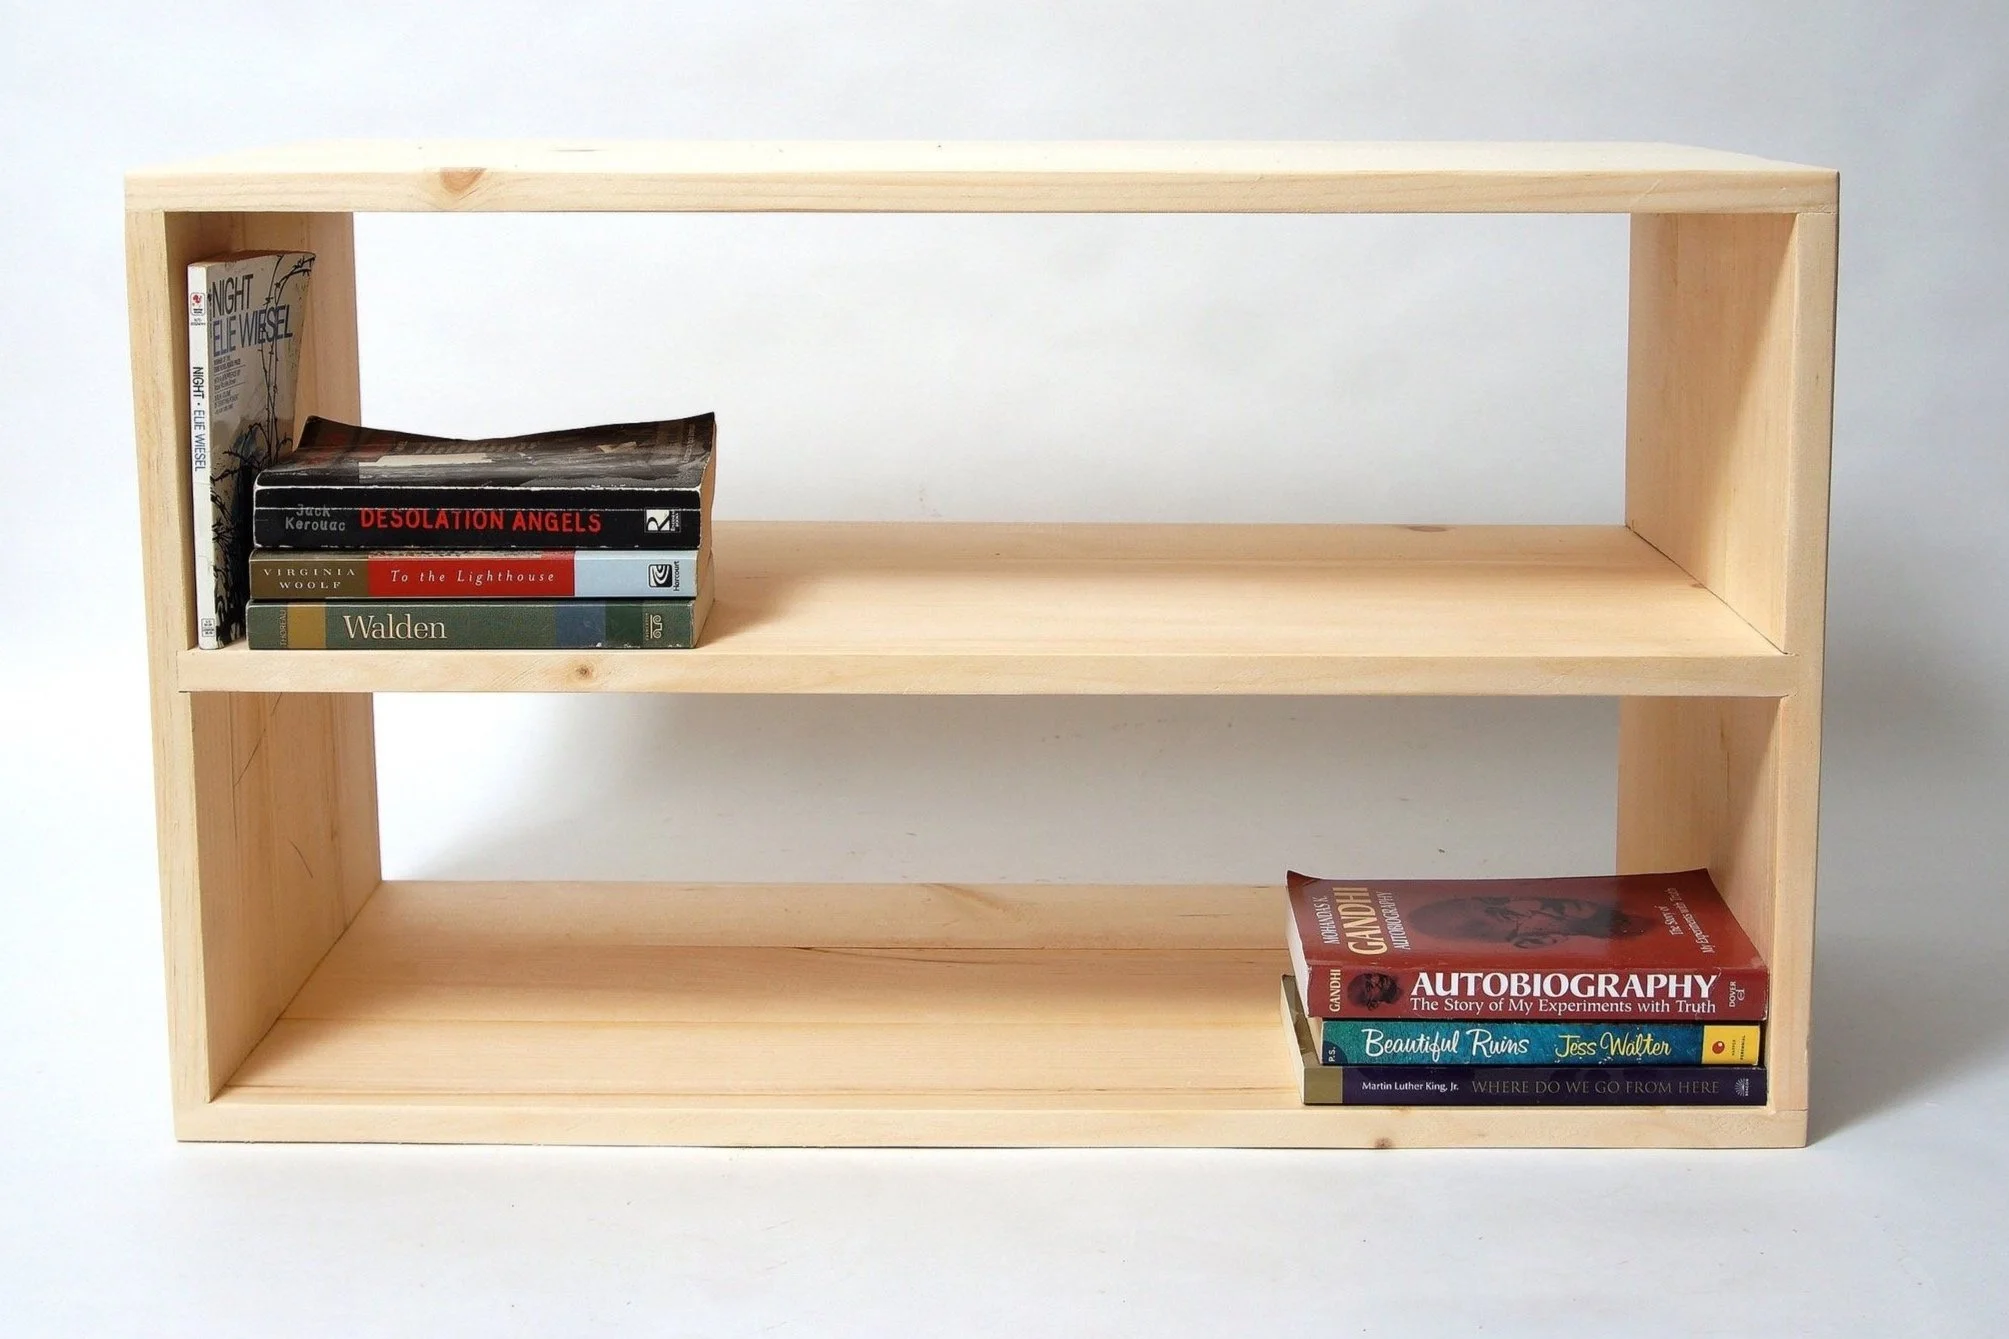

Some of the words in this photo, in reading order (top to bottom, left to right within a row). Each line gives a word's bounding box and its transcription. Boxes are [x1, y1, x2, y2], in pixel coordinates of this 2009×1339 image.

[212, 273, 254, 318] NIGHT
[212, 315, 237, 358] ELIE
[238, 304, 294, 349] WIESEL
[192, 366, 205, 399] NIGHT
[193, 409, 206, 431] ELIE
[193, 433, 207, 472] WIESEL
[285, 516, 346, 532] Kerouac
[296, 503, 331, 518] Jack
[359, 507, 505, 531] DESOLATION
[512, 510, 602, 533] ANGELS
[262, 568, 356, 576] VIRGINIA
[279, 581, 342, 590] WOOLF
[390, 570, 408, 583] To
[419, 570, 446, 583] the
[456, 570, 554, 586] Lighthouse
[673, 560, 681, 592] Harcourt
[279, 609, 288, 647] THOREAU
[343, 613, 448, 640] Walden
[1315, 902, 1340, 945] MOHANDAS
[1332, 887, 1388, 955] GANDHI
[1376, 891, 1411, 951] AUTOBIOGRAPHY
[1328, 968, 1342, 1013] GANDHI
[1410, 971, 1718, 999] AUTOBIOGRAPHY
[1728, 981, 1737, 1008] DOVER
[1409, 997, 1439, 1012] The
[1443, 997, 1485, 1015] Story
[1488, 997, 1506, 1012] of
[1507, 999, 1534, 1016] My
[1538, 999, 1633, 1016] Experiments
[1636, 999, 1671, 1014] with
[1674, 999, 1717, 1014] Truth
[1328, 1046, 1336, 1062] P.S.
[1361, 1028, 1461, 1063] Beautiful
[1465, 1028, 1531, 1058] Ruins
[1554, 1034, 1598, 1058] Jess
[1599, 1031, 1672, 1057] Walter
[1361, 1081, 1393, 1091] Martin
[1394, 1081, 1425, 1091] Luther
[1425, 1081, 1448, 1093] King,
[1449, 1081, 1460, 1092] Jr.
[1471, 1080, 1530, 1094] WHERE
[1535, 1080, 1561, 1094] DO
[1565, 1080, 1594, 1094] WE
[1594, 1080, 1621, 1094] GO
[1625, 1080, 1672, 1095] FROM
[1678, 1080, 1720, 1095] HERE
